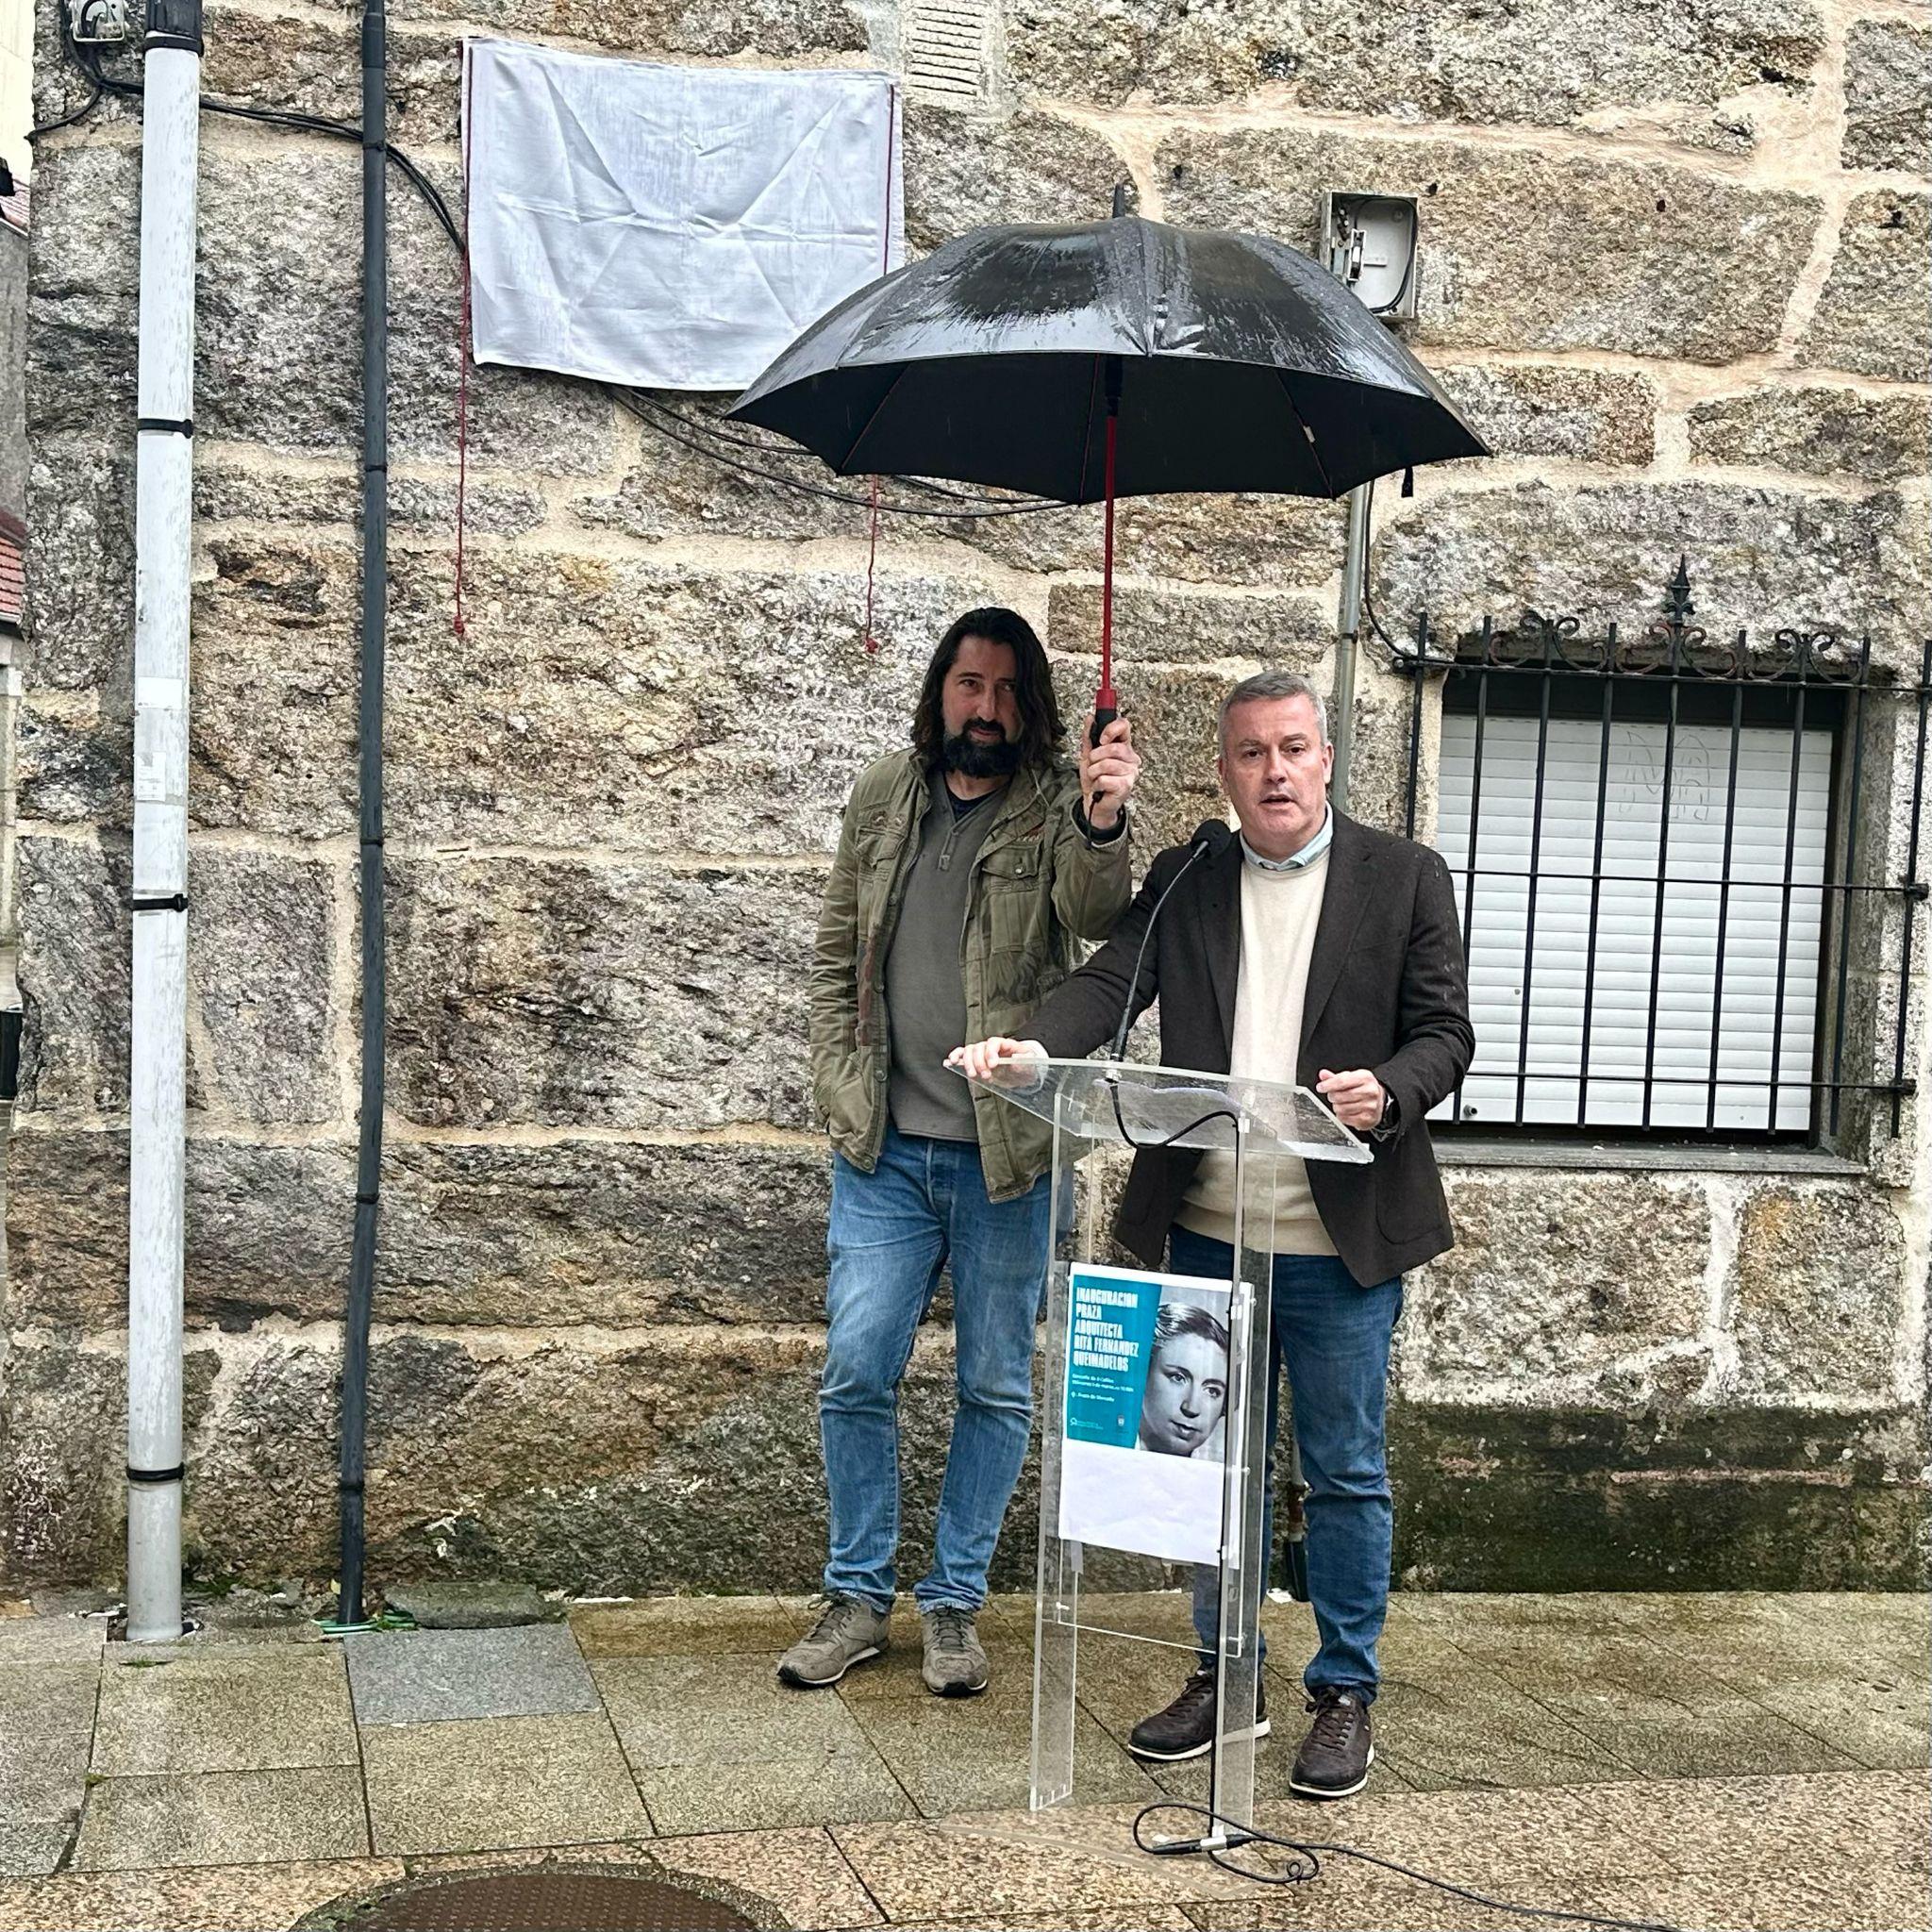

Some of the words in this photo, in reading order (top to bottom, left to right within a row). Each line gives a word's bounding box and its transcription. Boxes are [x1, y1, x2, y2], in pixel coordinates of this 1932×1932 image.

[1075, 1303, 1102, 1320] PRAZA
[1074, 1319, 1124, 1339] ARQUITECTA
[1074, 1334, 1092, 1351] RITA
[1073, 1351, 1129, 1373] QUEIMADELOS
